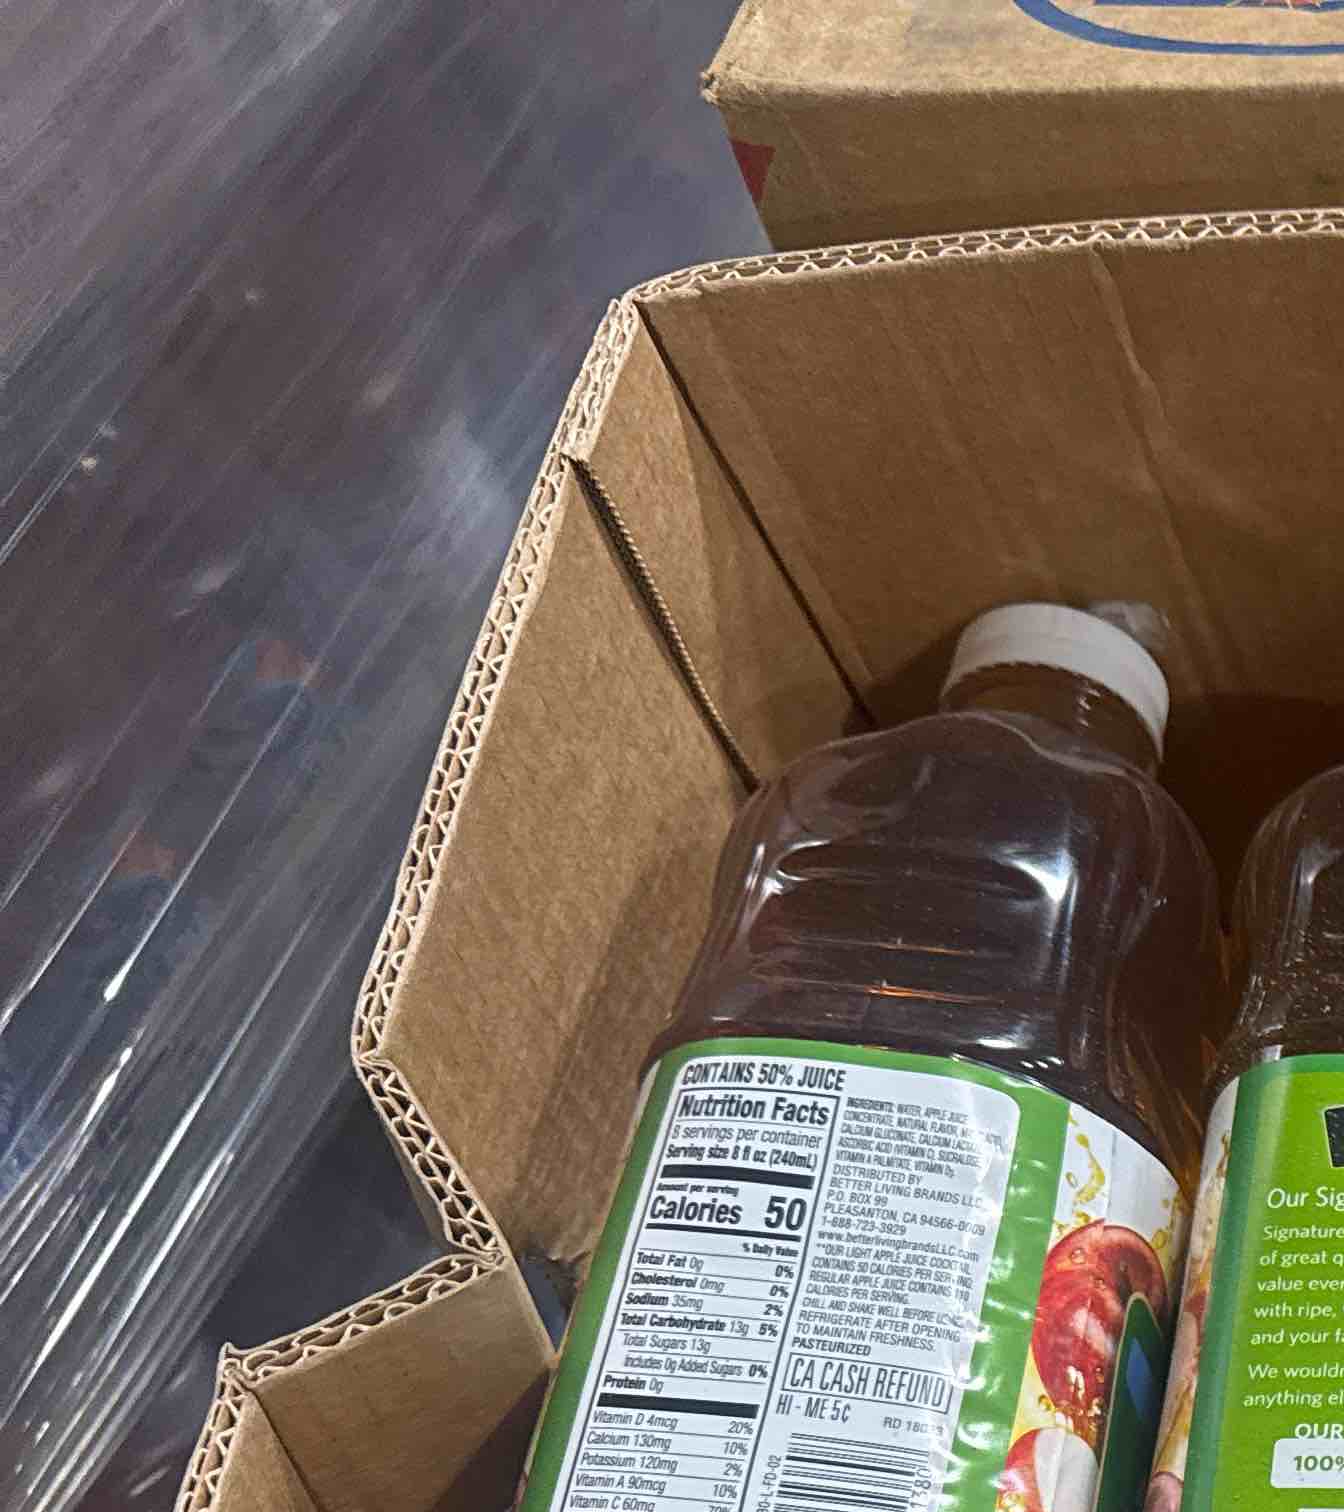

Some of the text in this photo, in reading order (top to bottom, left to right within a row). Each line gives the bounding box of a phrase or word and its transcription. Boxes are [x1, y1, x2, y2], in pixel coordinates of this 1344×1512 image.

[682, 1061, 845, 1091] CONTAINS 50% JUICE
[679, 1095, 830, 1126] Nutrition Facts
[1267, 1188, 1309, 1208] Our
[650, 1195, 807, 1231] Calories 50
[792, 1337, 871, 1356] PASTEURIZED
[1251, 1330, 1284, 1345] and
[1289, 1331, 1329, 1347] your
[1248, 1364, 1278, 1378] We
[790, 1358, 945, 1408] CA CASH REFUND
[776, 1394, 792, 1416] HI
[805, 1397, 829, 1420] ME
[1244, 1390, 1322, 1409] anything
[1294, 1423, 1344, 1440] OUR
